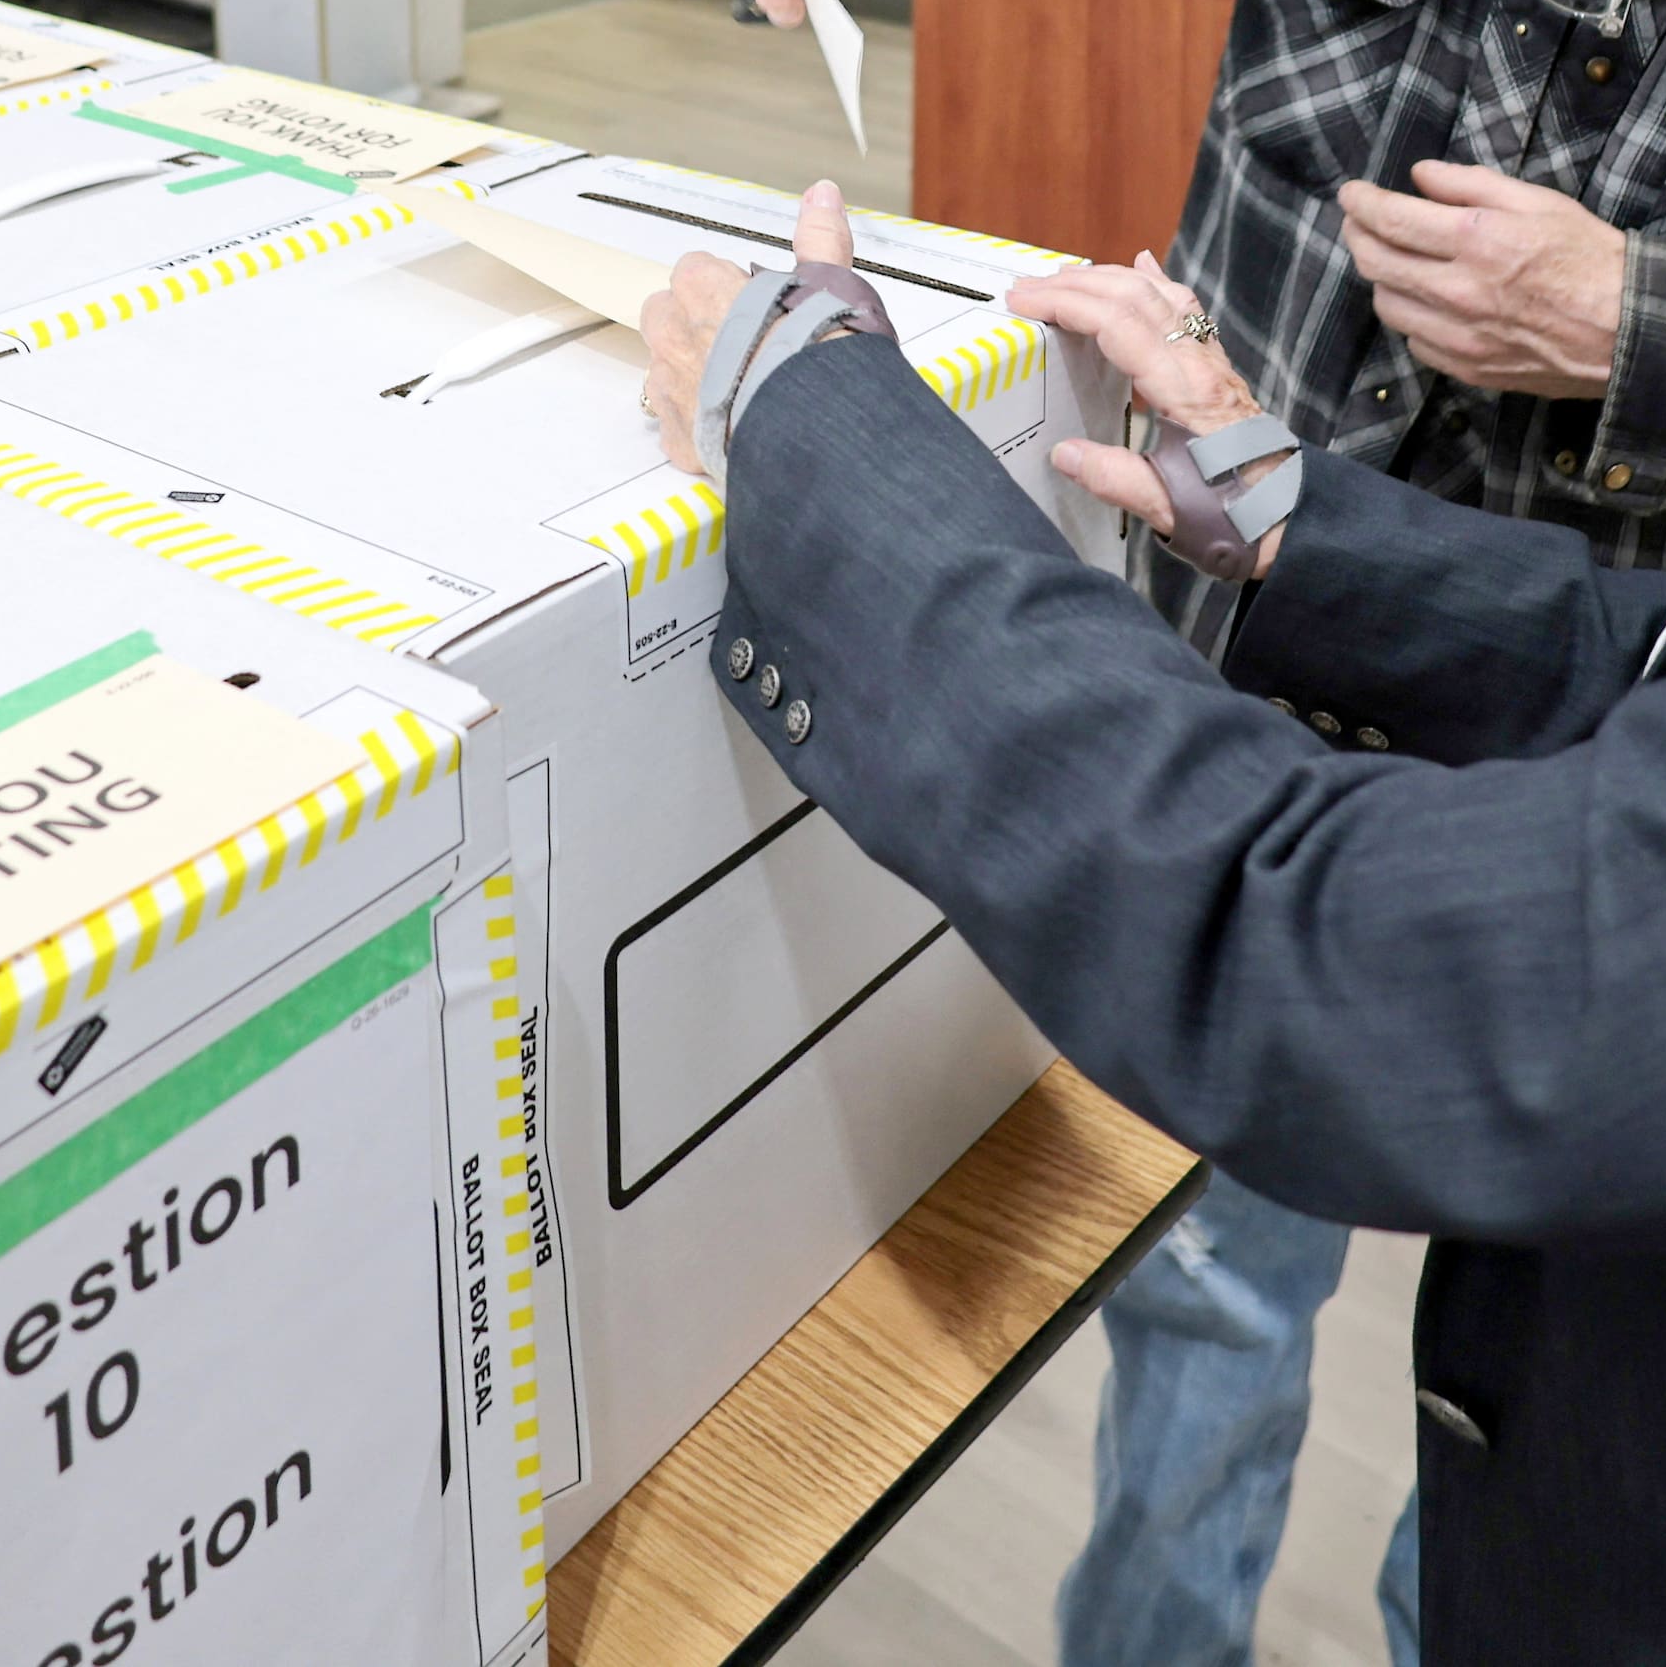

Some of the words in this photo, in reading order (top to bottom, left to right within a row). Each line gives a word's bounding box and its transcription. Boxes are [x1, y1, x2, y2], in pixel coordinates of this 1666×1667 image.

[201, 107, 268, 130] YOU
[237, 98, 347, 134] VOTING
[269, 125, 367, 160] THANK
[344, 128, 412, 149] FOR
[635, 618, 677, 651] E-22-505
[521, 1004, 538, 1081] SEAL
[463, 1153, 484, 1271] BALLOT
[526, 1153, 552, 1268] BALLOT
[468, 1276, 491, 1340] BOX
[44, 1351, 140, 1474] 10
[473, 1350, 493, 1426] SEAL
[36, 1448, 313, 1667] stion
